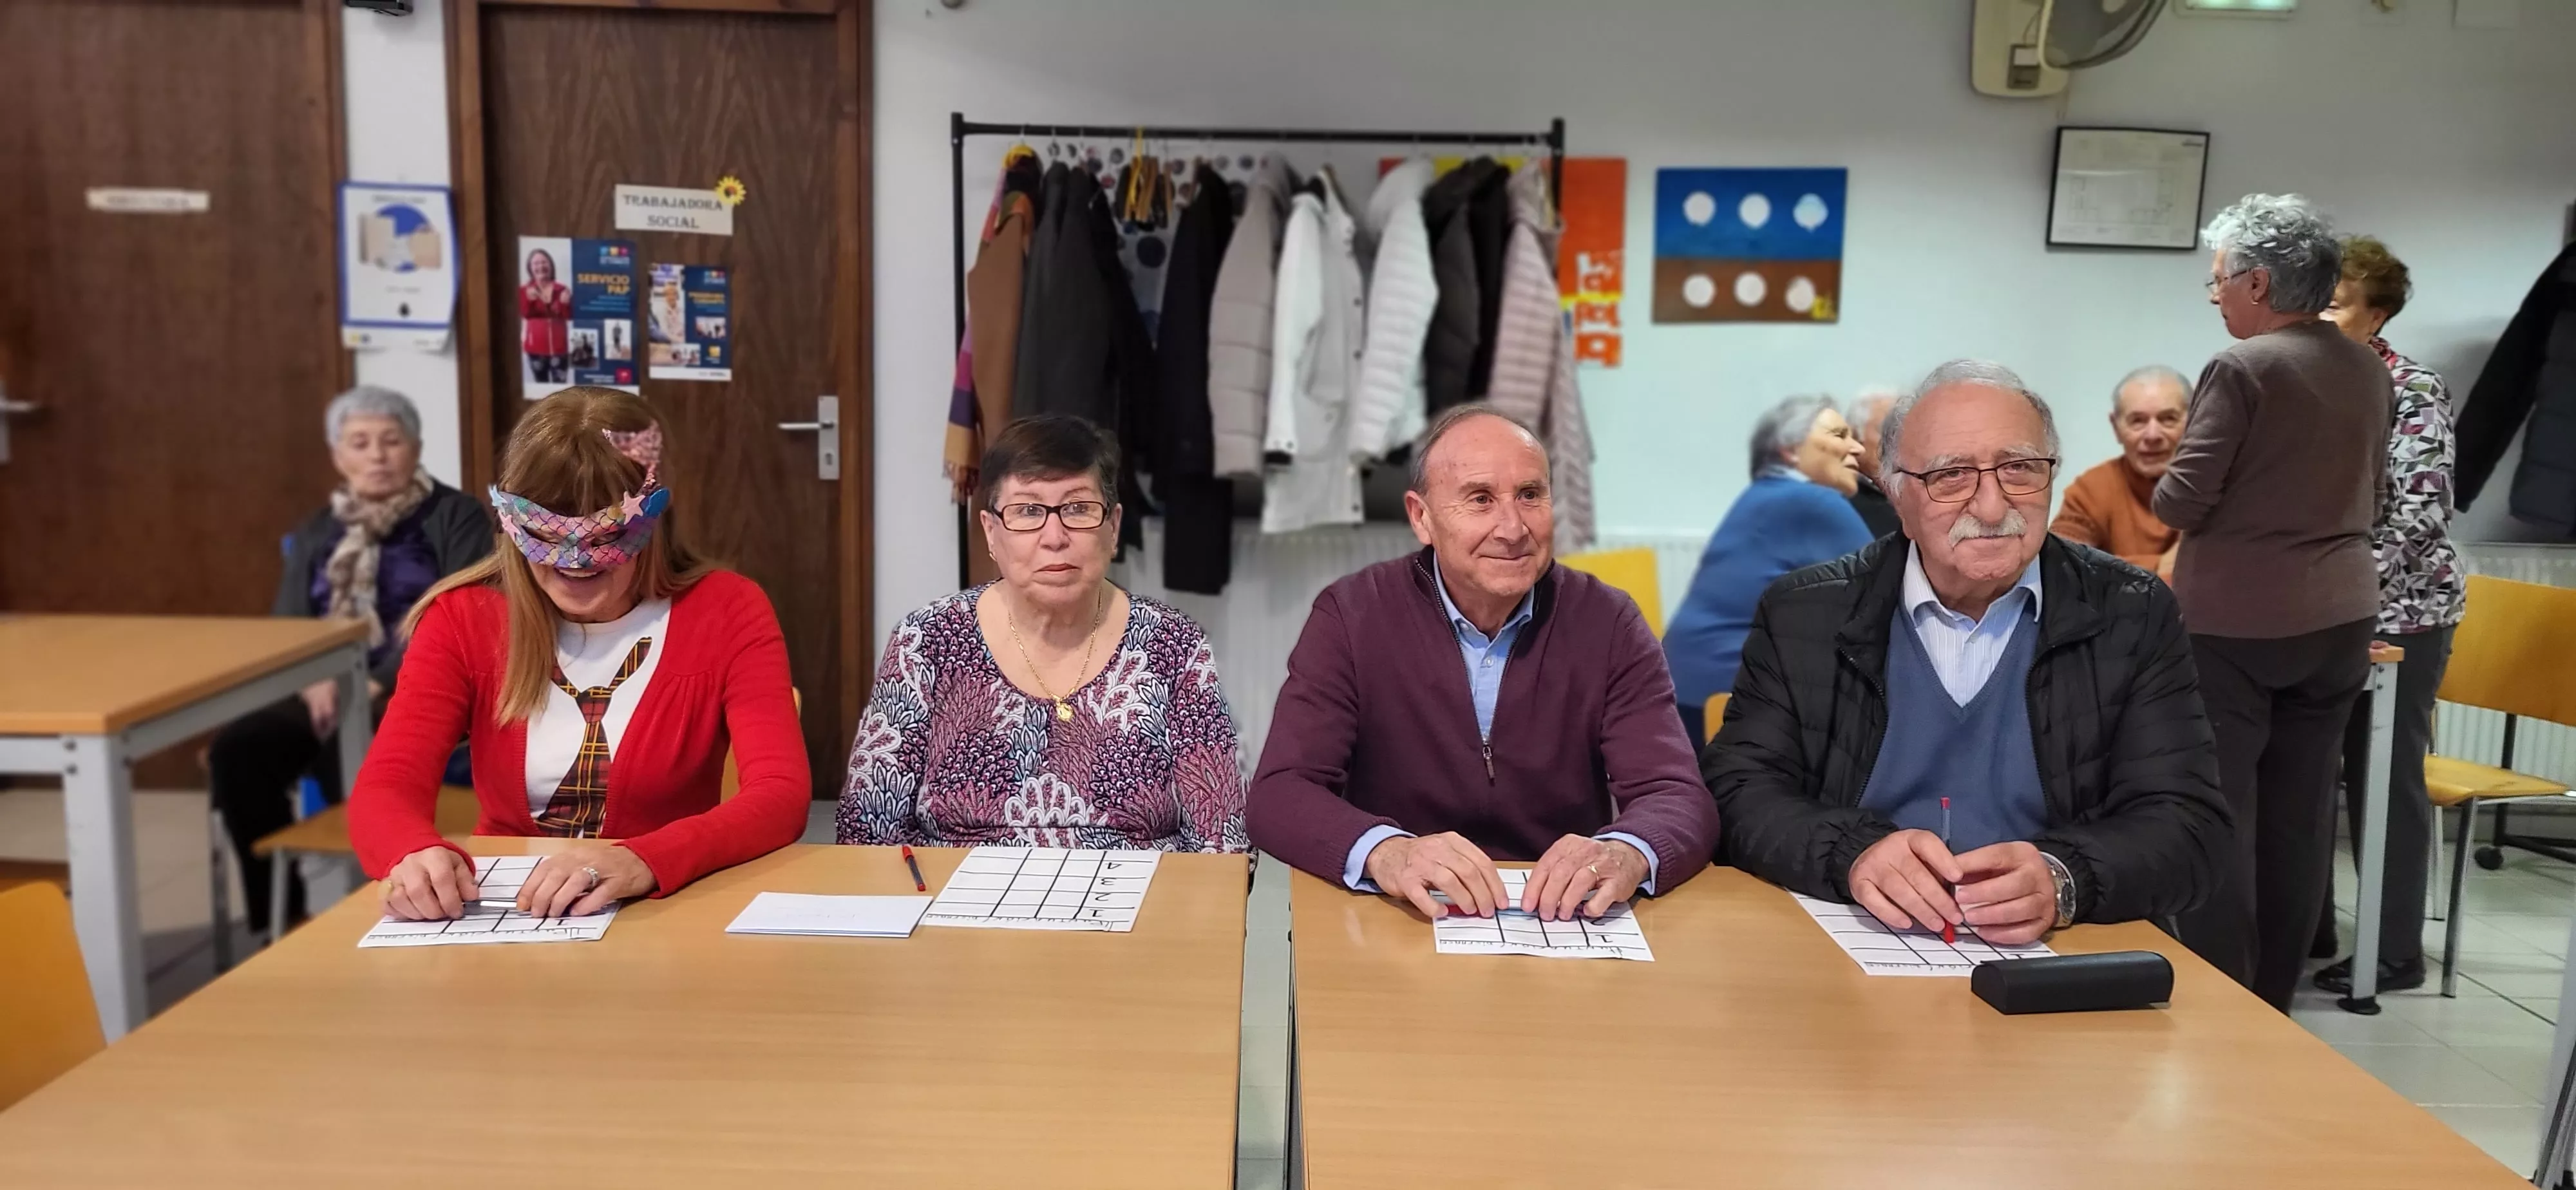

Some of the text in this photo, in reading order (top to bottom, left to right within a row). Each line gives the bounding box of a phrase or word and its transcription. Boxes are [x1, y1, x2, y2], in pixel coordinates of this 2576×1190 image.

[622, 194, 723, 211] TRABAJADORA
[647, 214, 699, 229] SOCIAL
[577, 273, 630, 285] SERVICIO
[1106, 862, 1122, 870] 4
[1101, 877, 1117, 886] 3
[1095, 892, 1113, 902] 2
[1088, 909, 1105, 918] 1
[556, 918, 572, 927] 1
[1595, 934, 1613, 943] 1
